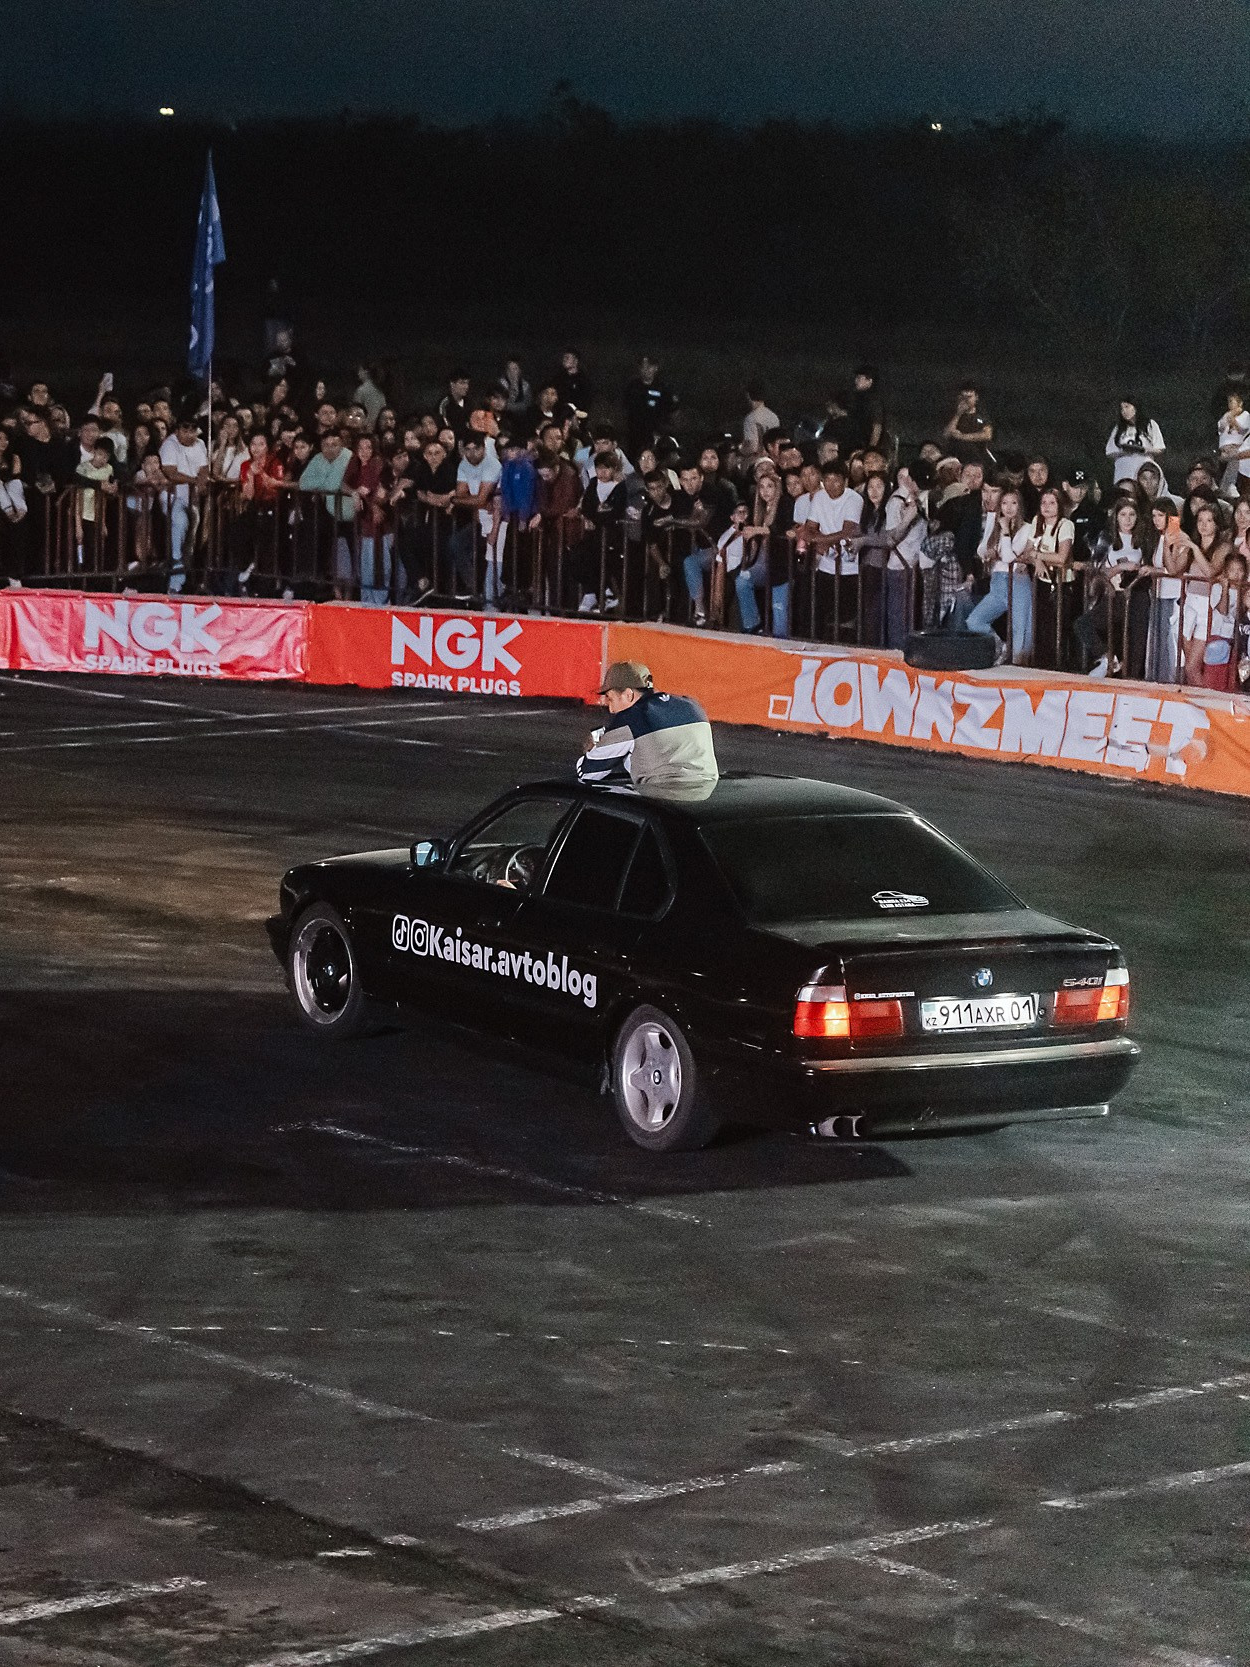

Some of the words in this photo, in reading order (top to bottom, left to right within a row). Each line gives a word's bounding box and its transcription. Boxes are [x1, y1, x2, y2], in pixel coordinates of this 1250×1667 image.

[84, 600, 223, 656] NGK
[391, 615, 524, 676] NGK
[84, 654, 150, 673] SPARK
[154, 658, 222, 676] PLUGS
[391, 671, 453, 691] SPARK
[456, 676, 521, 697] PLUGS
[429, 925, 597, 1008] Kaisar.avtoblog
[925, 1017, 938, 1027] KZ
[1010, 999, 1032, 1021] 01
